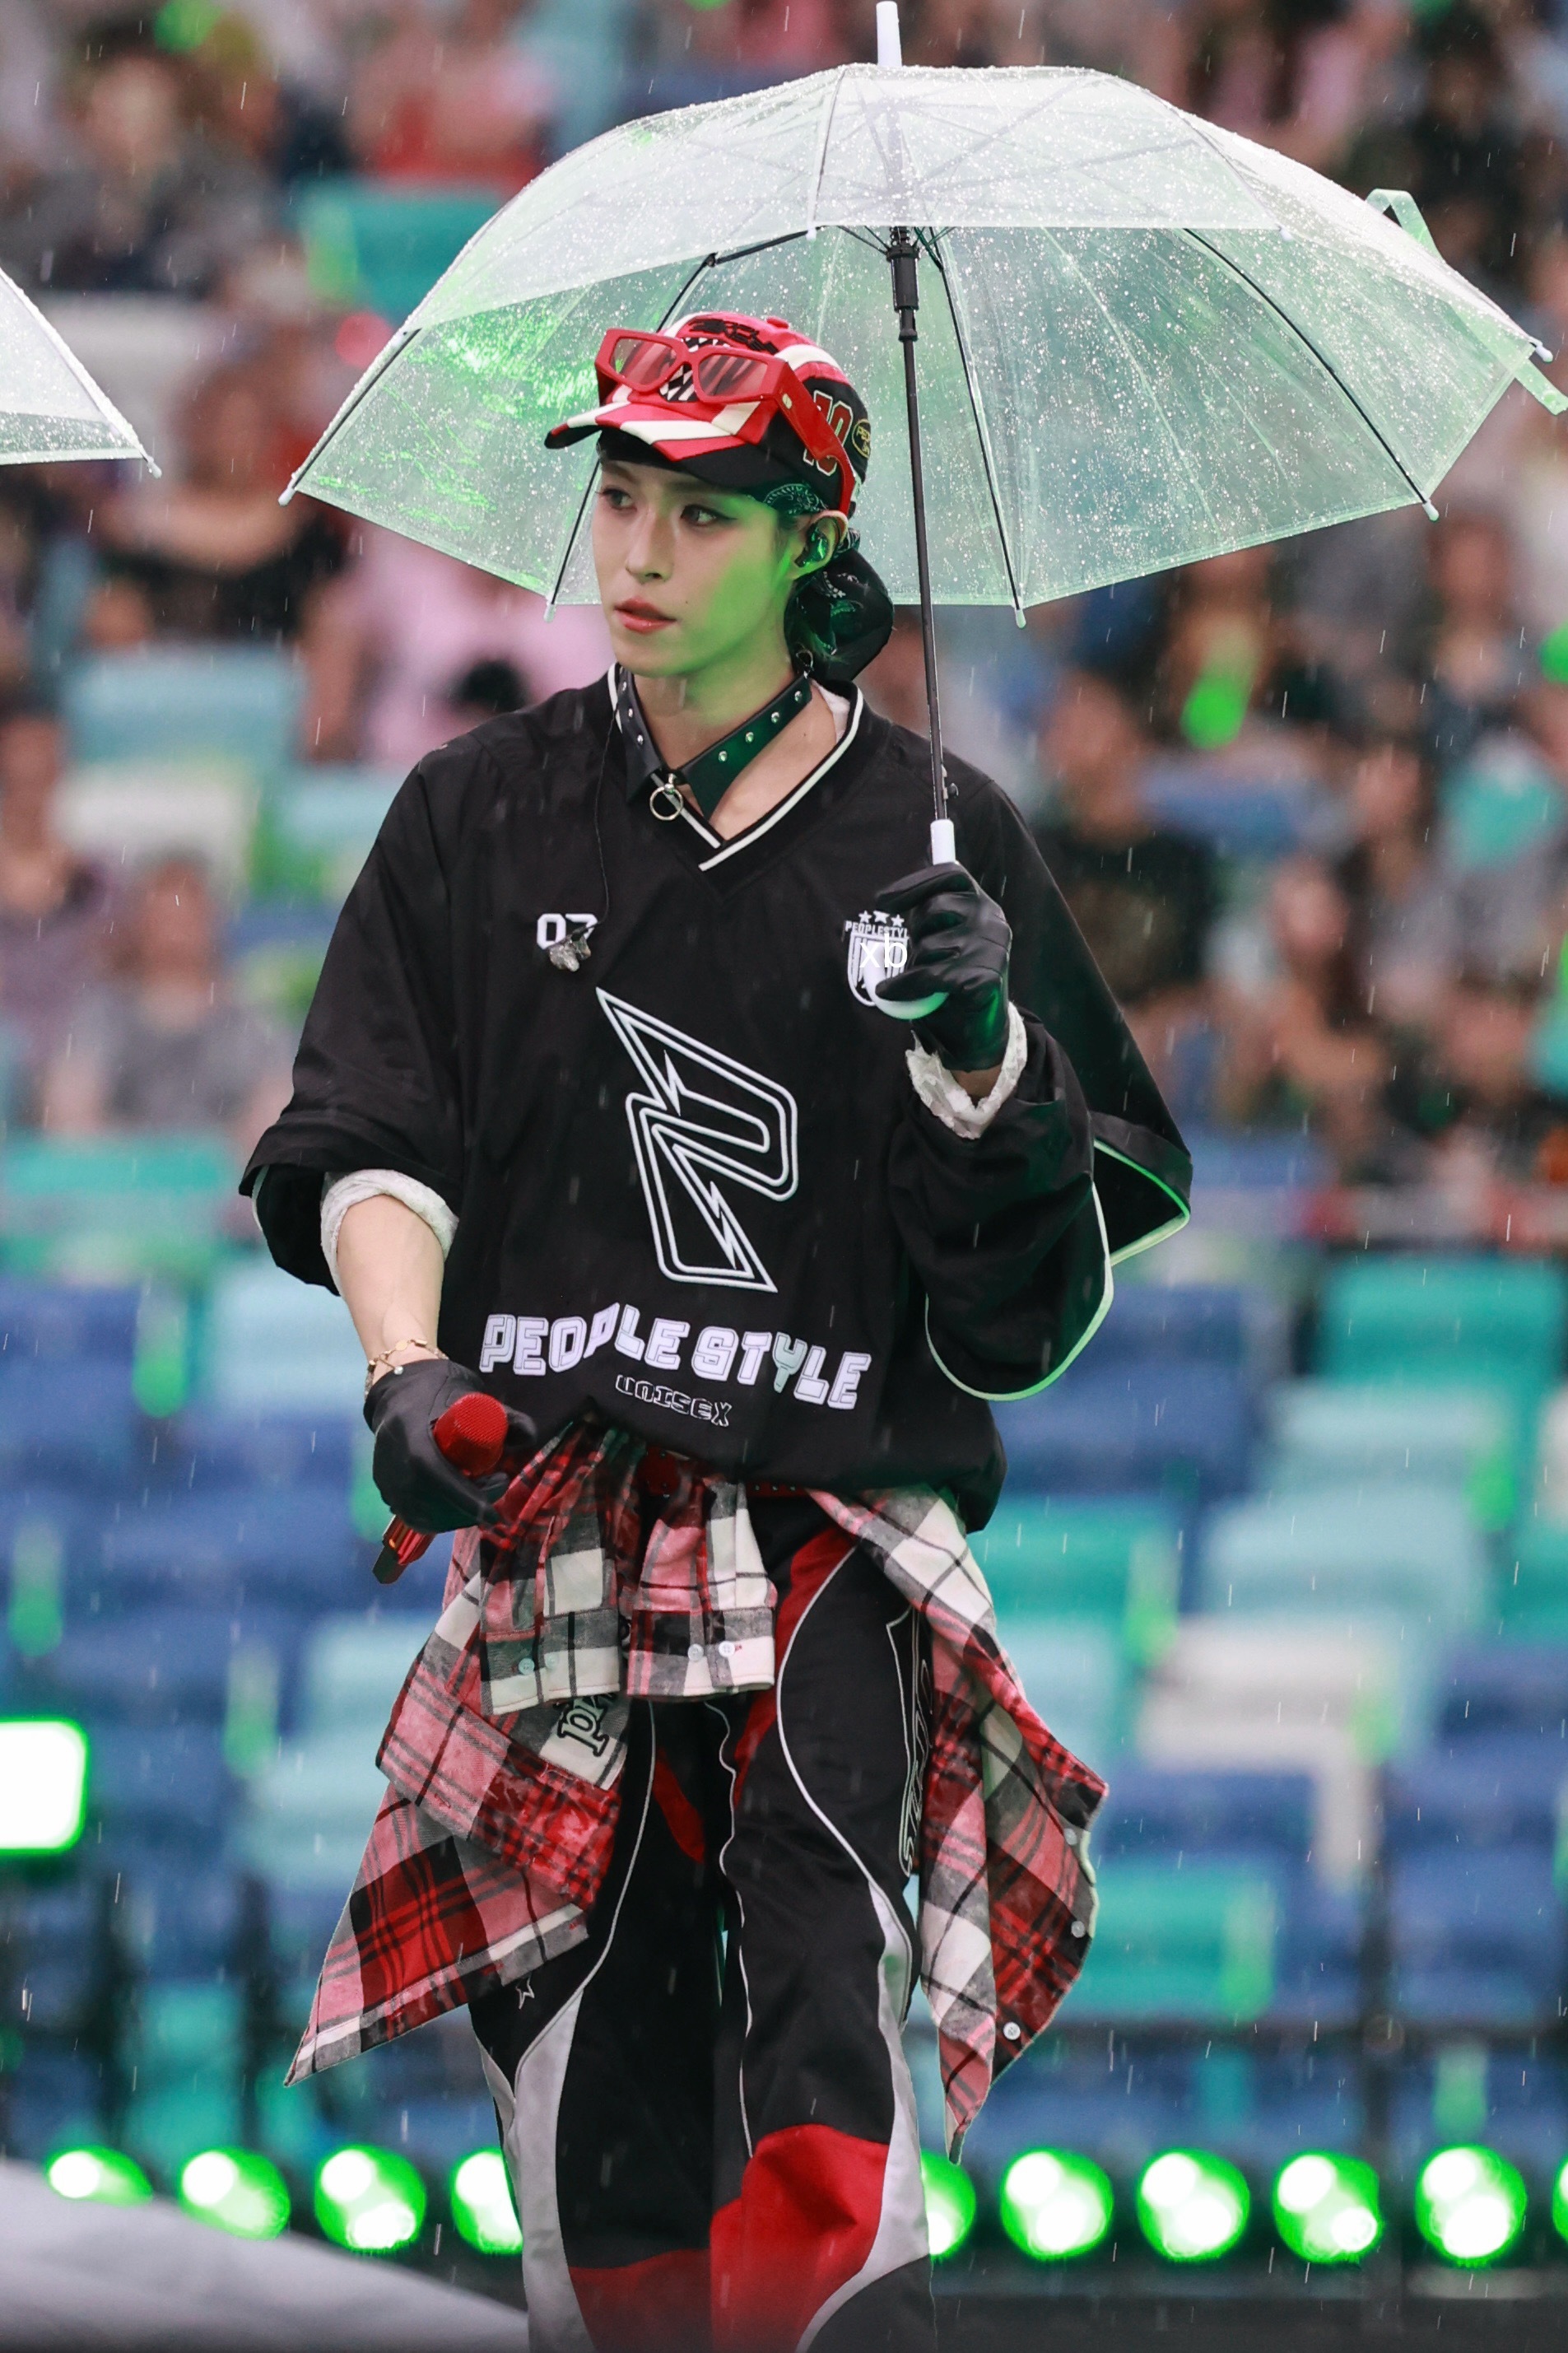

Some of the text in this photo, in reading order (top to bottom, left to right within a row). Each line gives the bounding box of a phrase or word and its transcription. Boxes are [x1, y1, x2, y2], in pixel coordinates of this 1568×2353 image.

[537, 913, 598, 950] 07
[844, 920, 909, 939] PEOPLESTYL
[479, 1302, 872, 1409] PEOPLE STYLE
